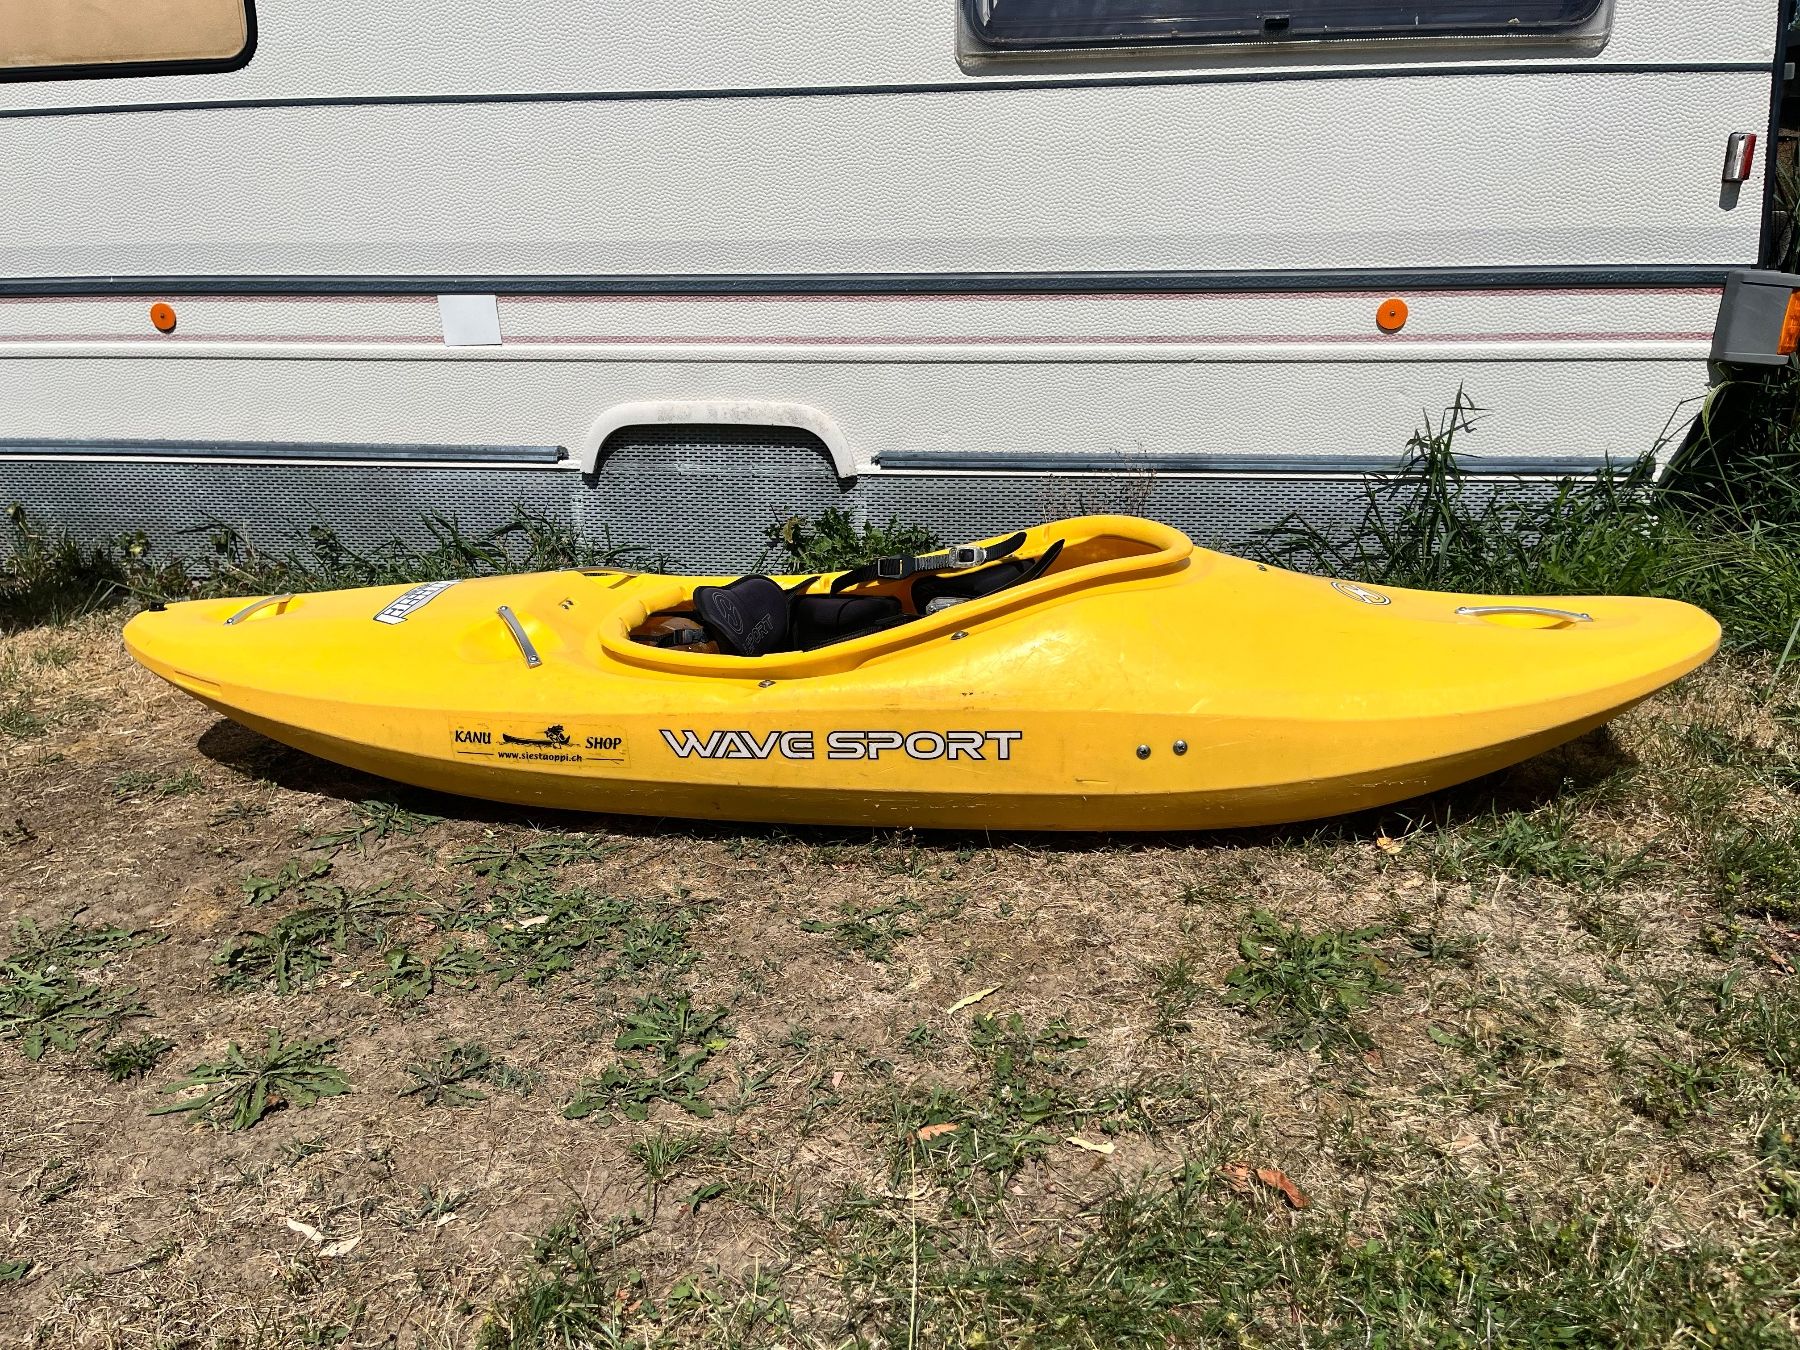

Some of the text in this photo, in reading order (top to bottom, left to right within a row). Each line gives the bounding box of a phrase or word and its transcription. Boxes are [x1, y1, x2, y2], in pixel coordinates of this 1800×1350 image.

[454, 730, 622, 750] KANU SHOP
[659, 729, 1023, 761] WAVE SPORT
[497, 751, 583, 763] www.siestaoppi.ch
